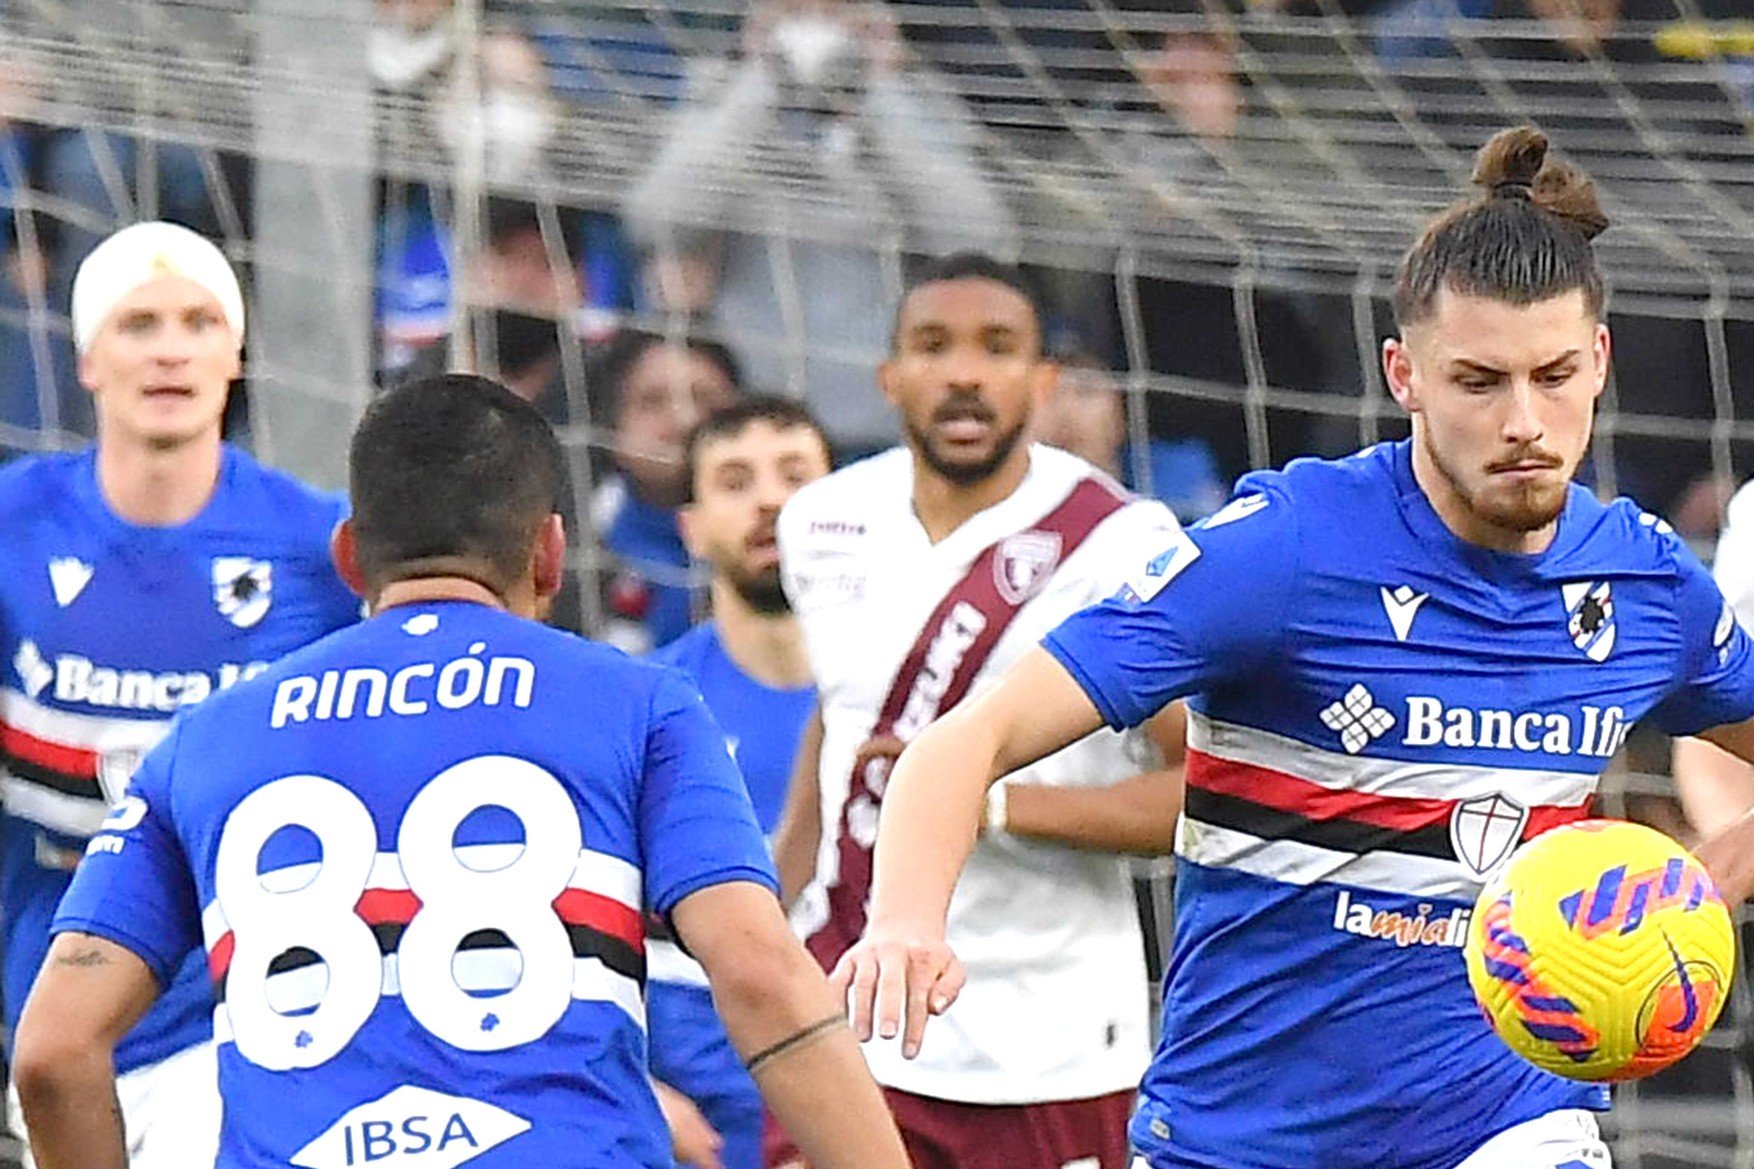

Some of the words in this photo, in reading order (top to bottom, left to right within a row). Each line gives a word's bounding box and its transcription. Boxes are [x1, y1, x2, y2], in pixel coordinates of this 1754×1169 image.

[55, 654, 211, 712] Banca
[270, 643, 536, 728] RINCÓN
[1402, 696, 1571, 755] Banca
[215, 755, 582, 1071] 88
[1333, 890, 1470, 948] lamiali
[344, 1111, 479, 1167] IBSA
